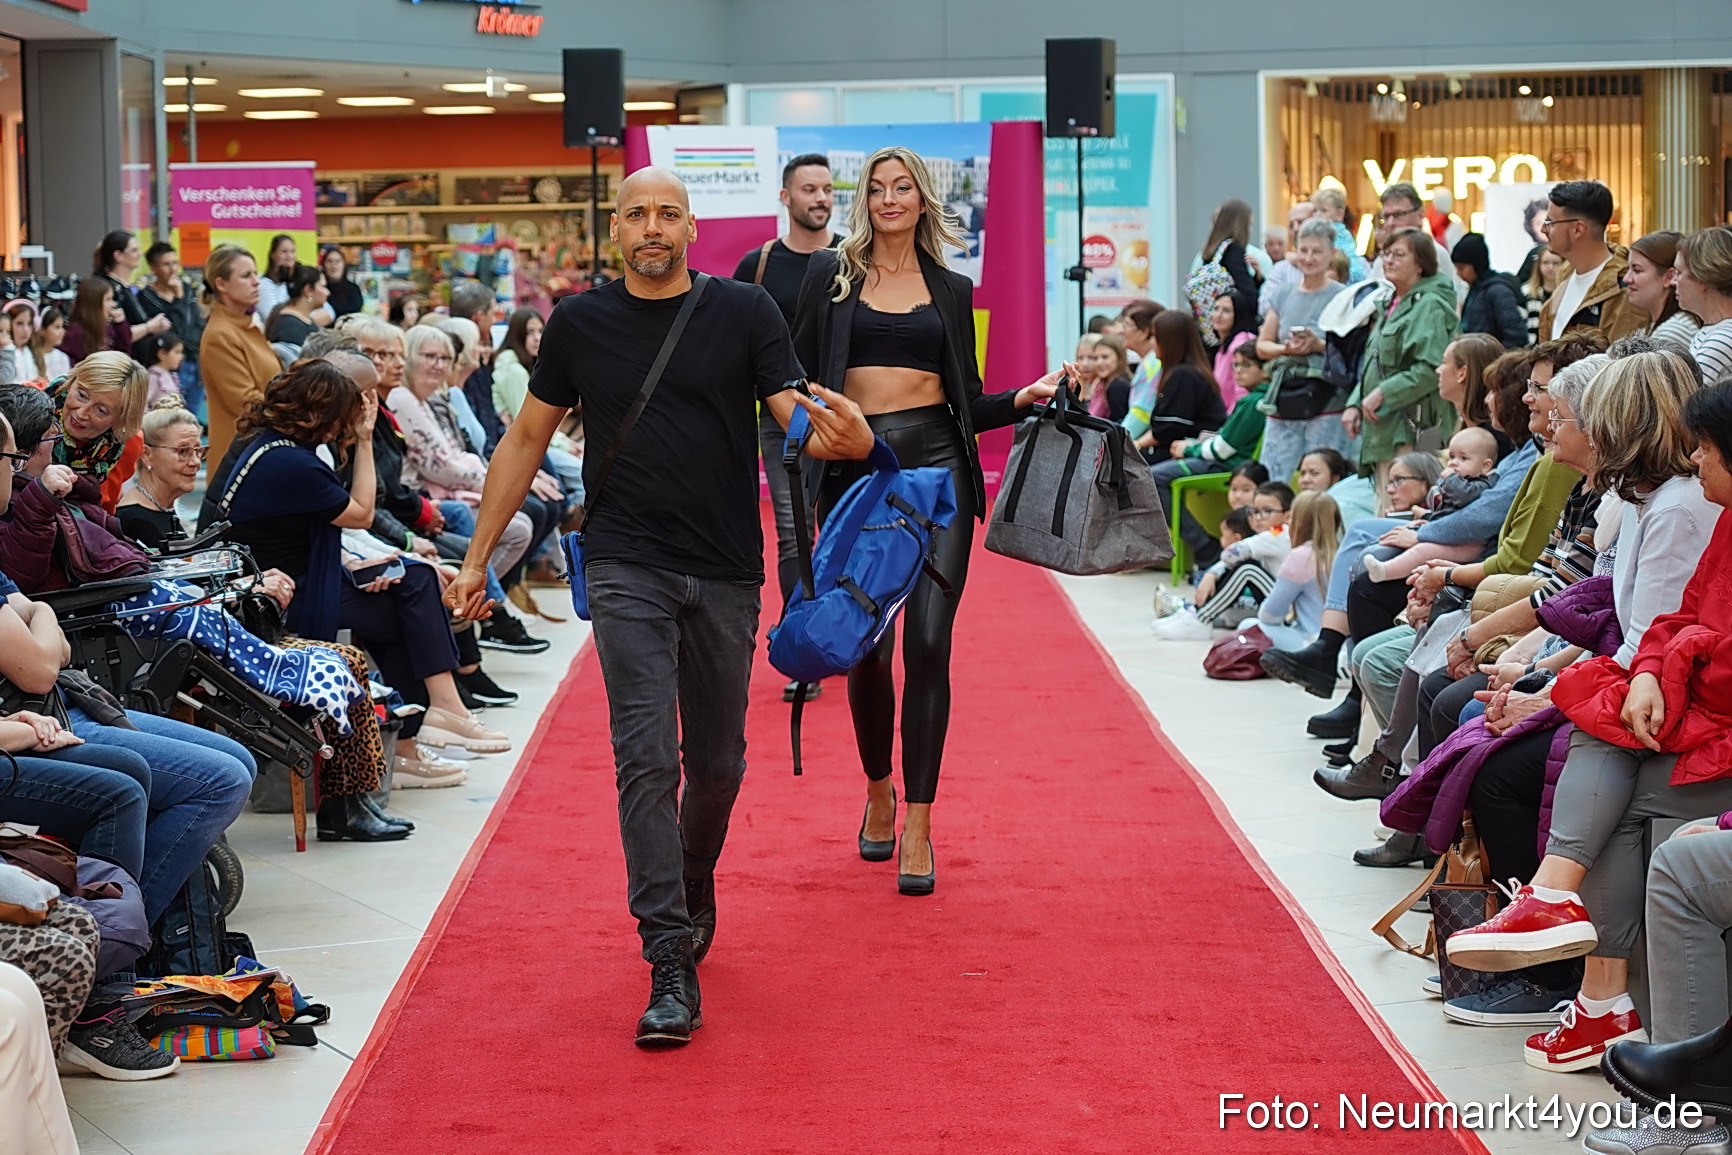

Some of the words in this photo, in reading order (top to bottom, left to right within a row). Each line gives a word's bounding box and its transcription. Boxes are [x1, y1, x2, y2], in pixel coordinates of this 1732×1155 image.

[477, 5, 543, 36] Krömer
[1363, 153, 1548, 200] VERO
[178, 186, 275, 203] Verschenken
[276, 185, 302, 201] Sie
[211, 201, 303, 219] Gutscheine!
